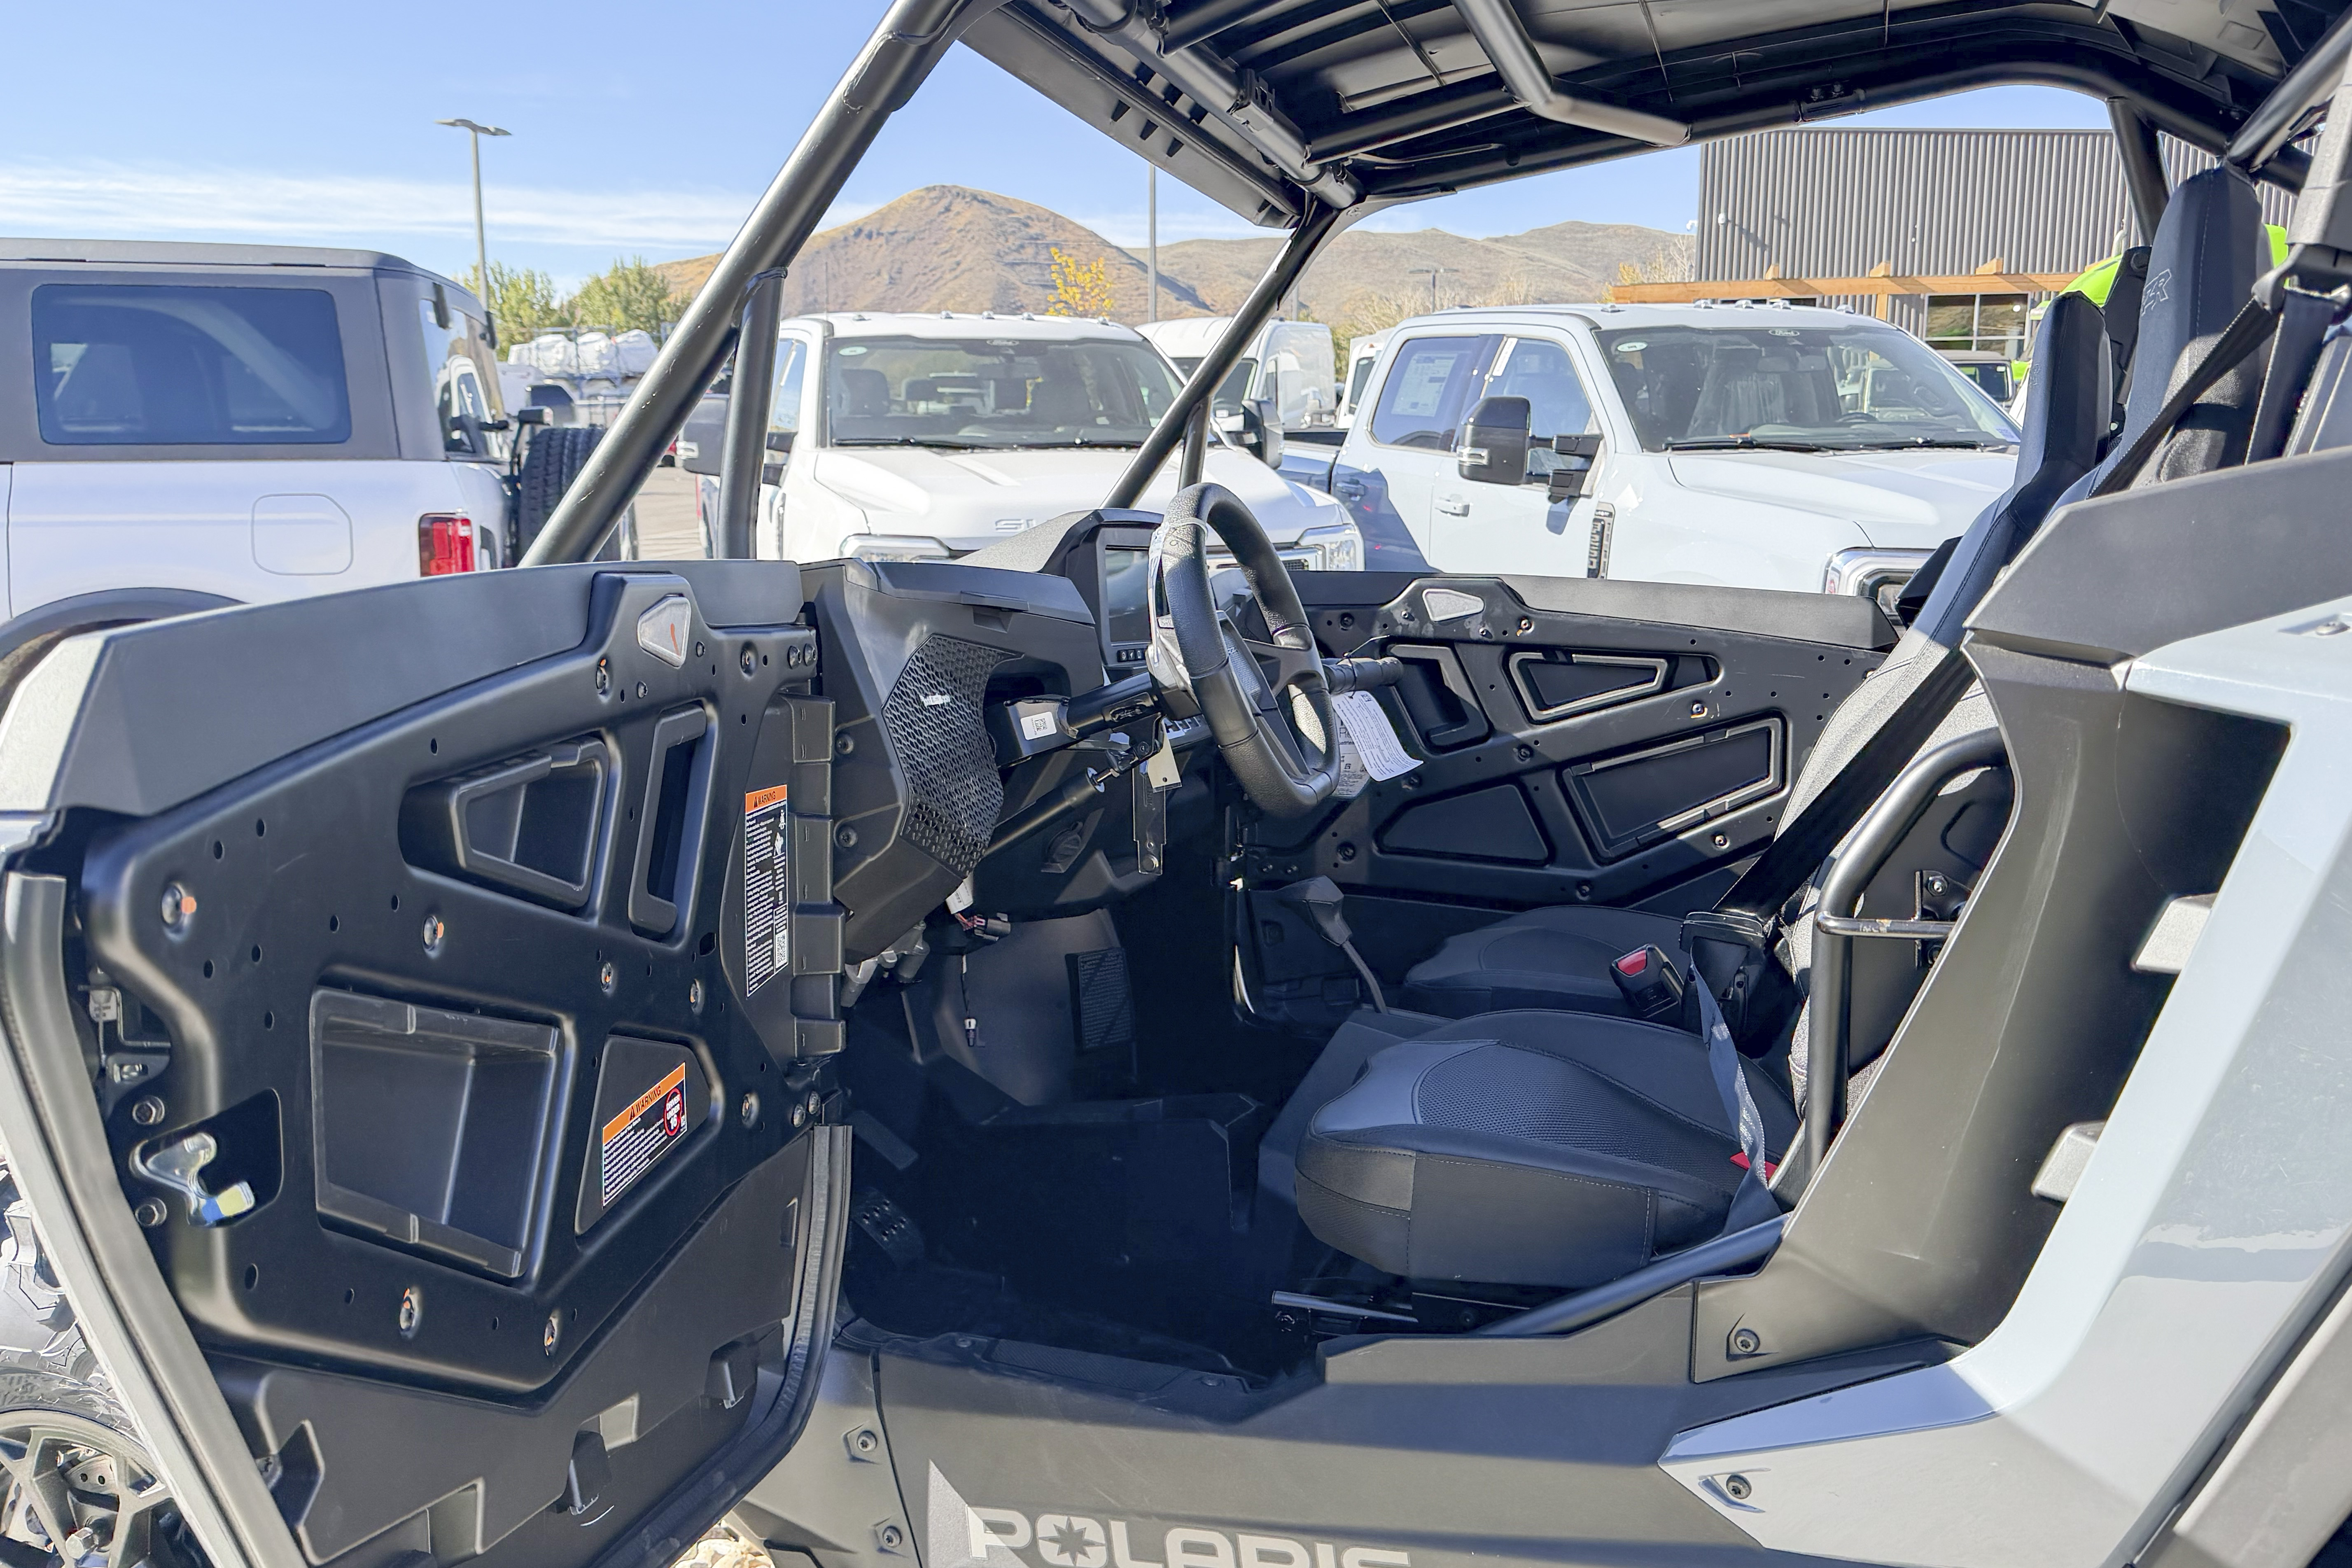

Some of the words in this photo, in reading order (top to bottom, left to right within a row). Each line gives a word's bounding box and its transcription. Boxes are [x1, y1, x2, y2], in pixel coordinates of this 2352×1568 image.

[758, 791, 776, 805] WARNING
[636, 1085, 661, 1113] WARNING
[667, 1103, 680, 1120] UNDER
[670, 1114, 677, 1129] 16
